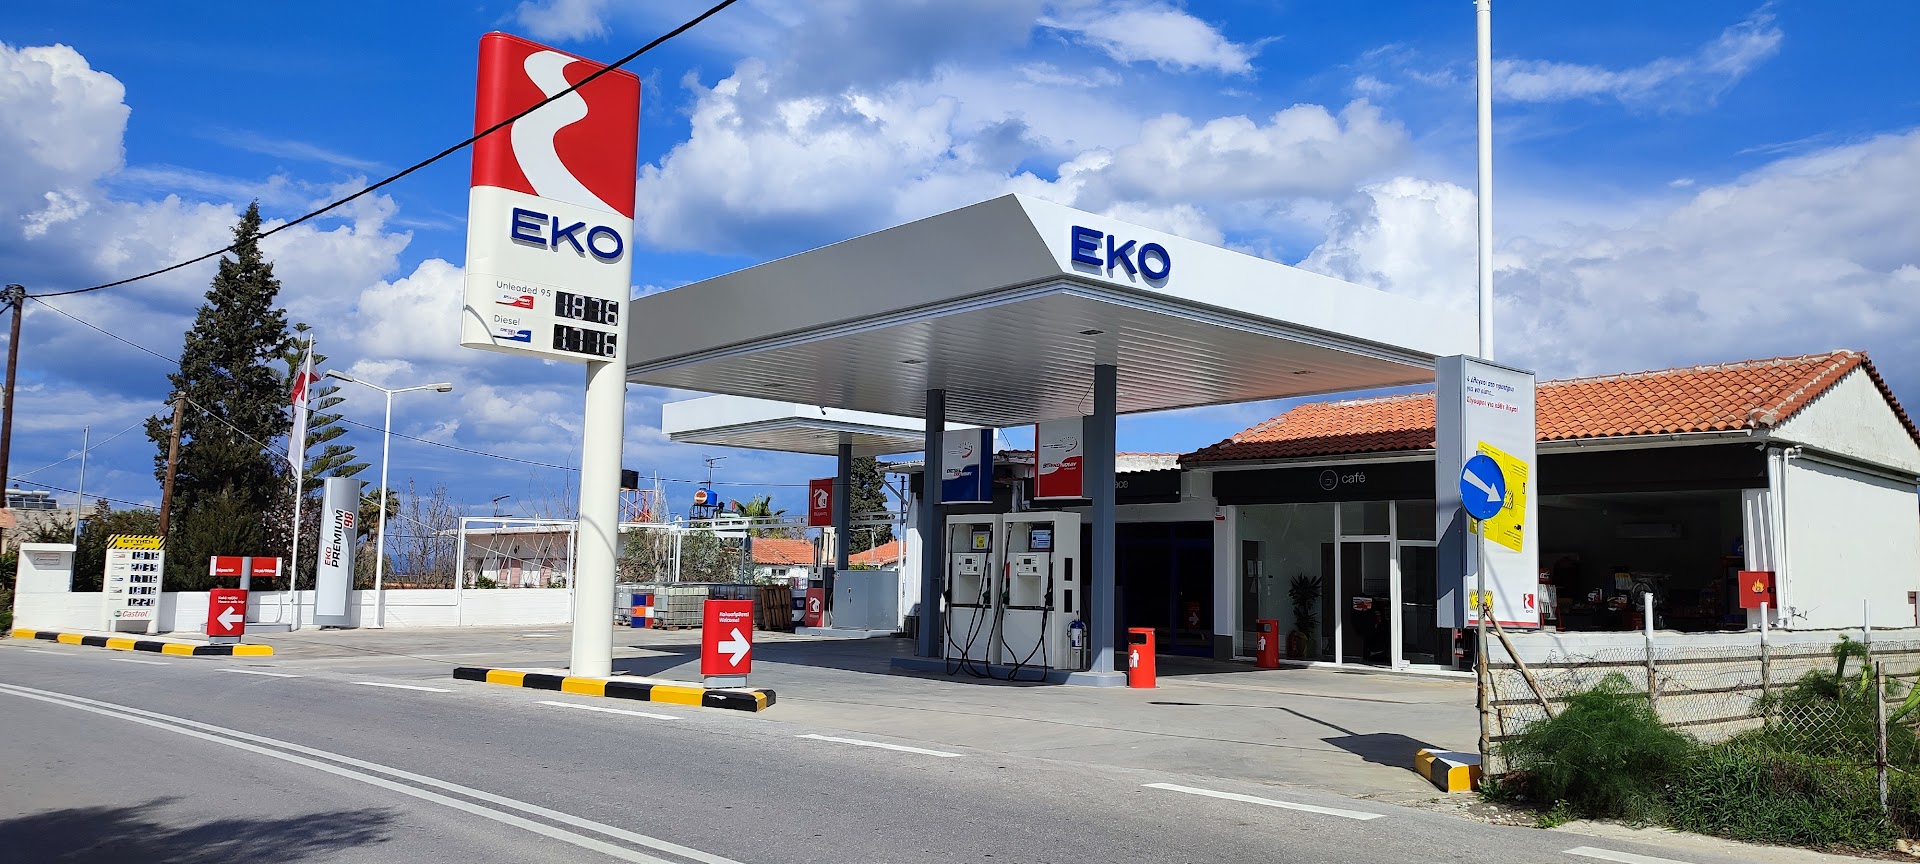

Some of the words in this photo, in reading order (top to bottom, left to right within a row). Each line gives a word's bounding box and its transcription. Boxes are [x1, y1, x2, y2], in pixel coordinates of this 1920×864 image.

[511, 207, 624, 263] EKO
[1071, 225, 1171, 283] EKO
[496, 280, 538, 295] Unleaded
[540, 289, 552, 298] 95
[493, 314, 521, 326] Diesel
[1115, 480, 1129, 489] ace
[1341, 471, 1366, 484] café
[344, 512, 354, 528] 98
[332, 510, 344, 568] PREMIUM
[122, 610, 149, 618] Castrol
